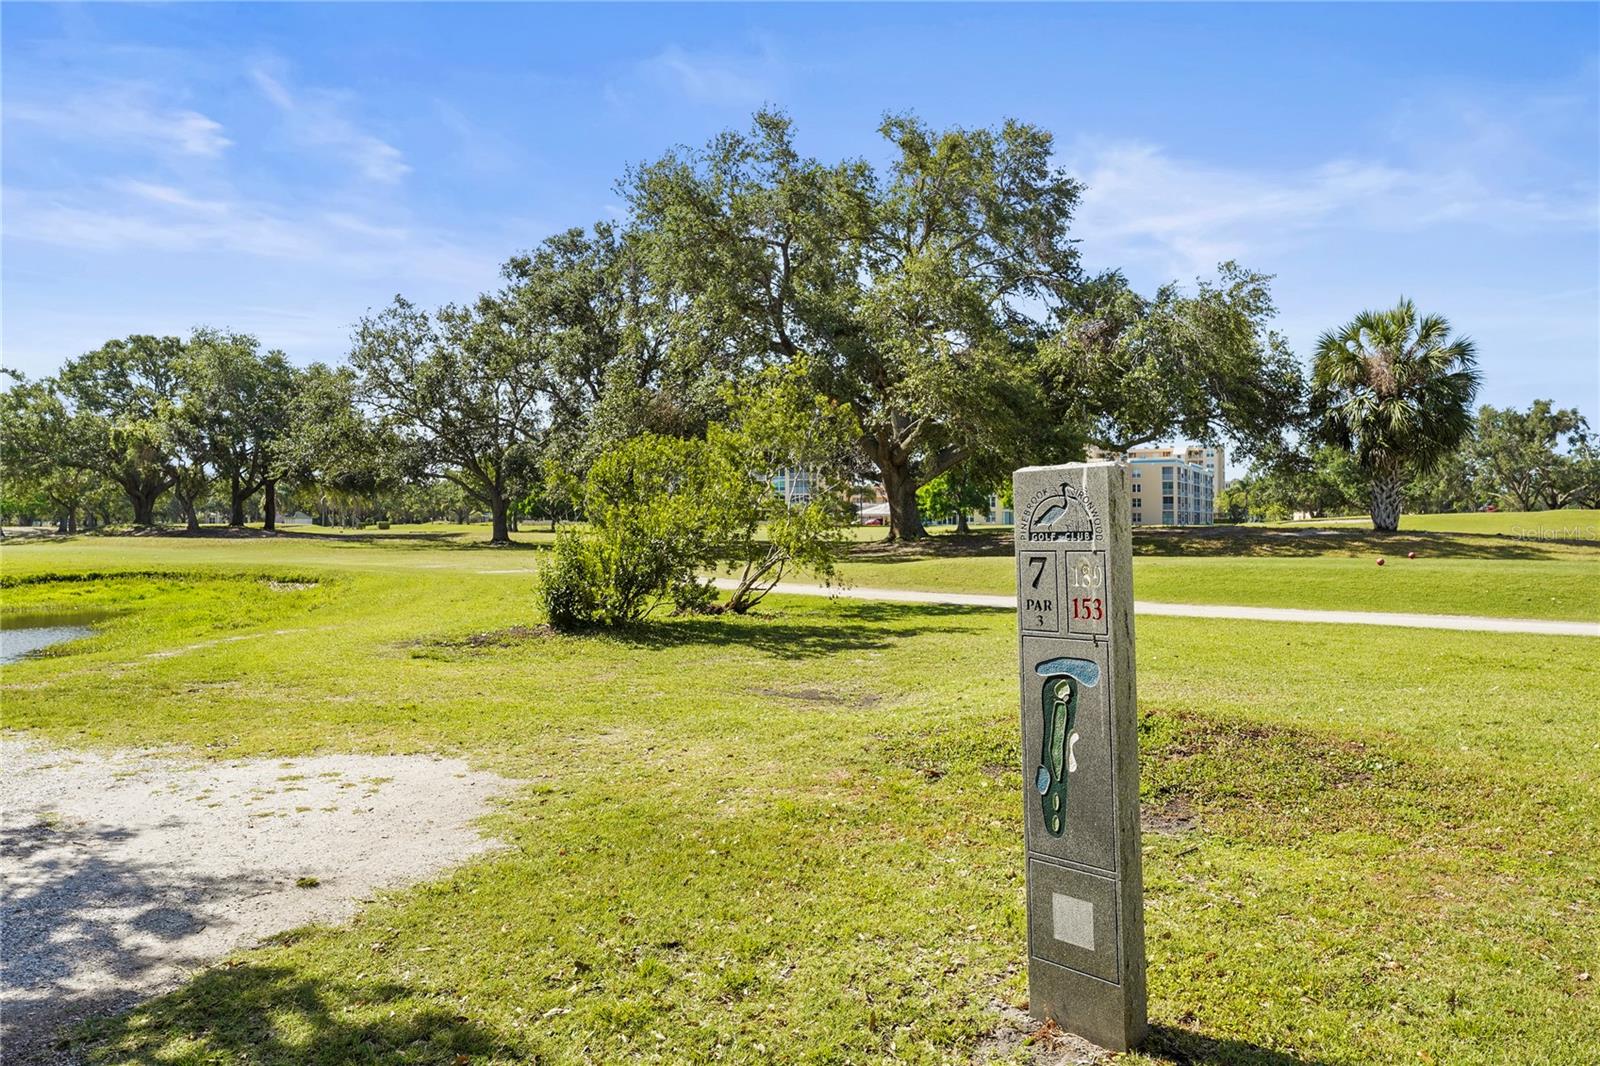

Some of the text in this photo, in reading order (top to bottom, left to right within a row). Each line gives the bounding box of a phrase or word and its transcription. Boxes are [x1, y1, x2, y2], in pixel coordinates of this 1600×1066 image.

[1020, 488, 1103, 541] PINEBROOK IRONWOOD
[1031, 532, 1090, 541] GOLF CLUB
[1029, 557, 1047, 589] 7
[1026, 599, 1052, 611] PAR
[1072, 598, 1103, 620] 153
[1038, 615, 1044, 627] 3
